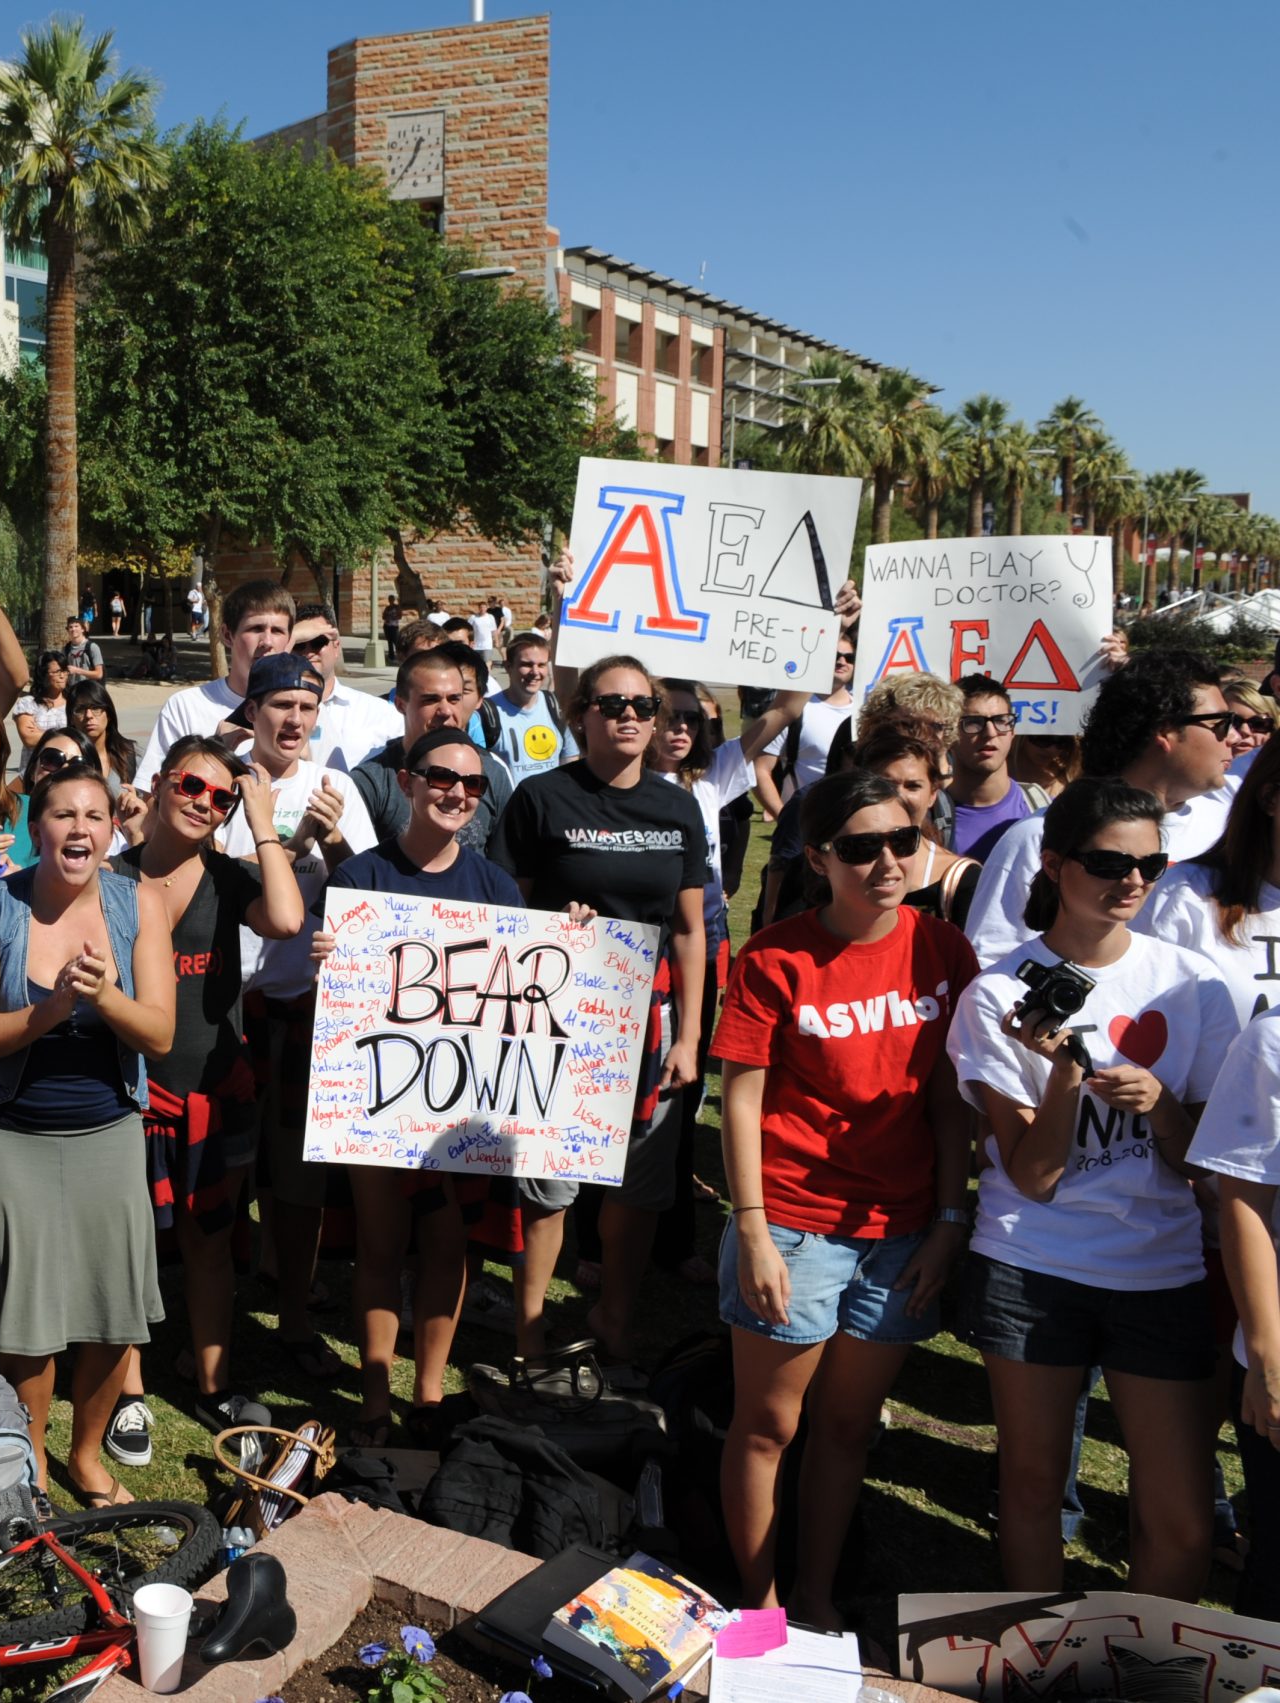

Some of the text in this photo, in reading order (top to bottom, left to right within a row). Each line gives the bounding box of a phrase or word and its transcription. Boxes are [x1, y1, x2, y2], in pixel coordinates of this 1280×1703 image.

[869, 550, 1044, 582] WANNA PLAY
[934, 580, 1062, 606] DOCTOR?
[733, 610, 795, 639] PRE-
[728, 638, 777, 664] MED
[395, 912, 414, 924] #2
[431, 902, 488, 929] Megan H
[496, 907, 529, 934] Lucy
[458, 922, 475, 933] #3
[496, 922, 517, 937] #4
[545, 914, 597, 948] Sydney
[606, 920, 645, 955] Rachel
[336, 943, 385, 958] Nic #32
[365, 961, 387, 975] #31
[604, 951, 637, 990] Billy
[323, 975, 391, 998] Megan M #30
[385, 937, 573, 1040] BEAR
[574, 971, 610, 991] Blake
[321, 991, 381, 1017] Morgan #29
[577, 997, 616, 1027] Gabby
[315, 1017, 354, 1035] Elyse
[354, 1013, 376, 1033] #27
[580, 1020, 604, 1035] #10
[619, 1022, 641, 1040] #9
[311, 1058, 345, 1073] Patrick
[355, 1030, 569, 1120] DOWN
[566, 1058, 605, 1082] Rylan
[348, 1077, 369, 1090] #25
[315, 1091, 363, 1105] Kim #24
[572, 1099, 628, 1145] Lisa #13
[539, 1126, 561, 1141] #35
[561, 1126, 598, 1146] Justin
[372, 1143, 393, 1158] #21
[465, 1147, 507, 1174] Wendy
[576, 1148, 604, 1167] #15
